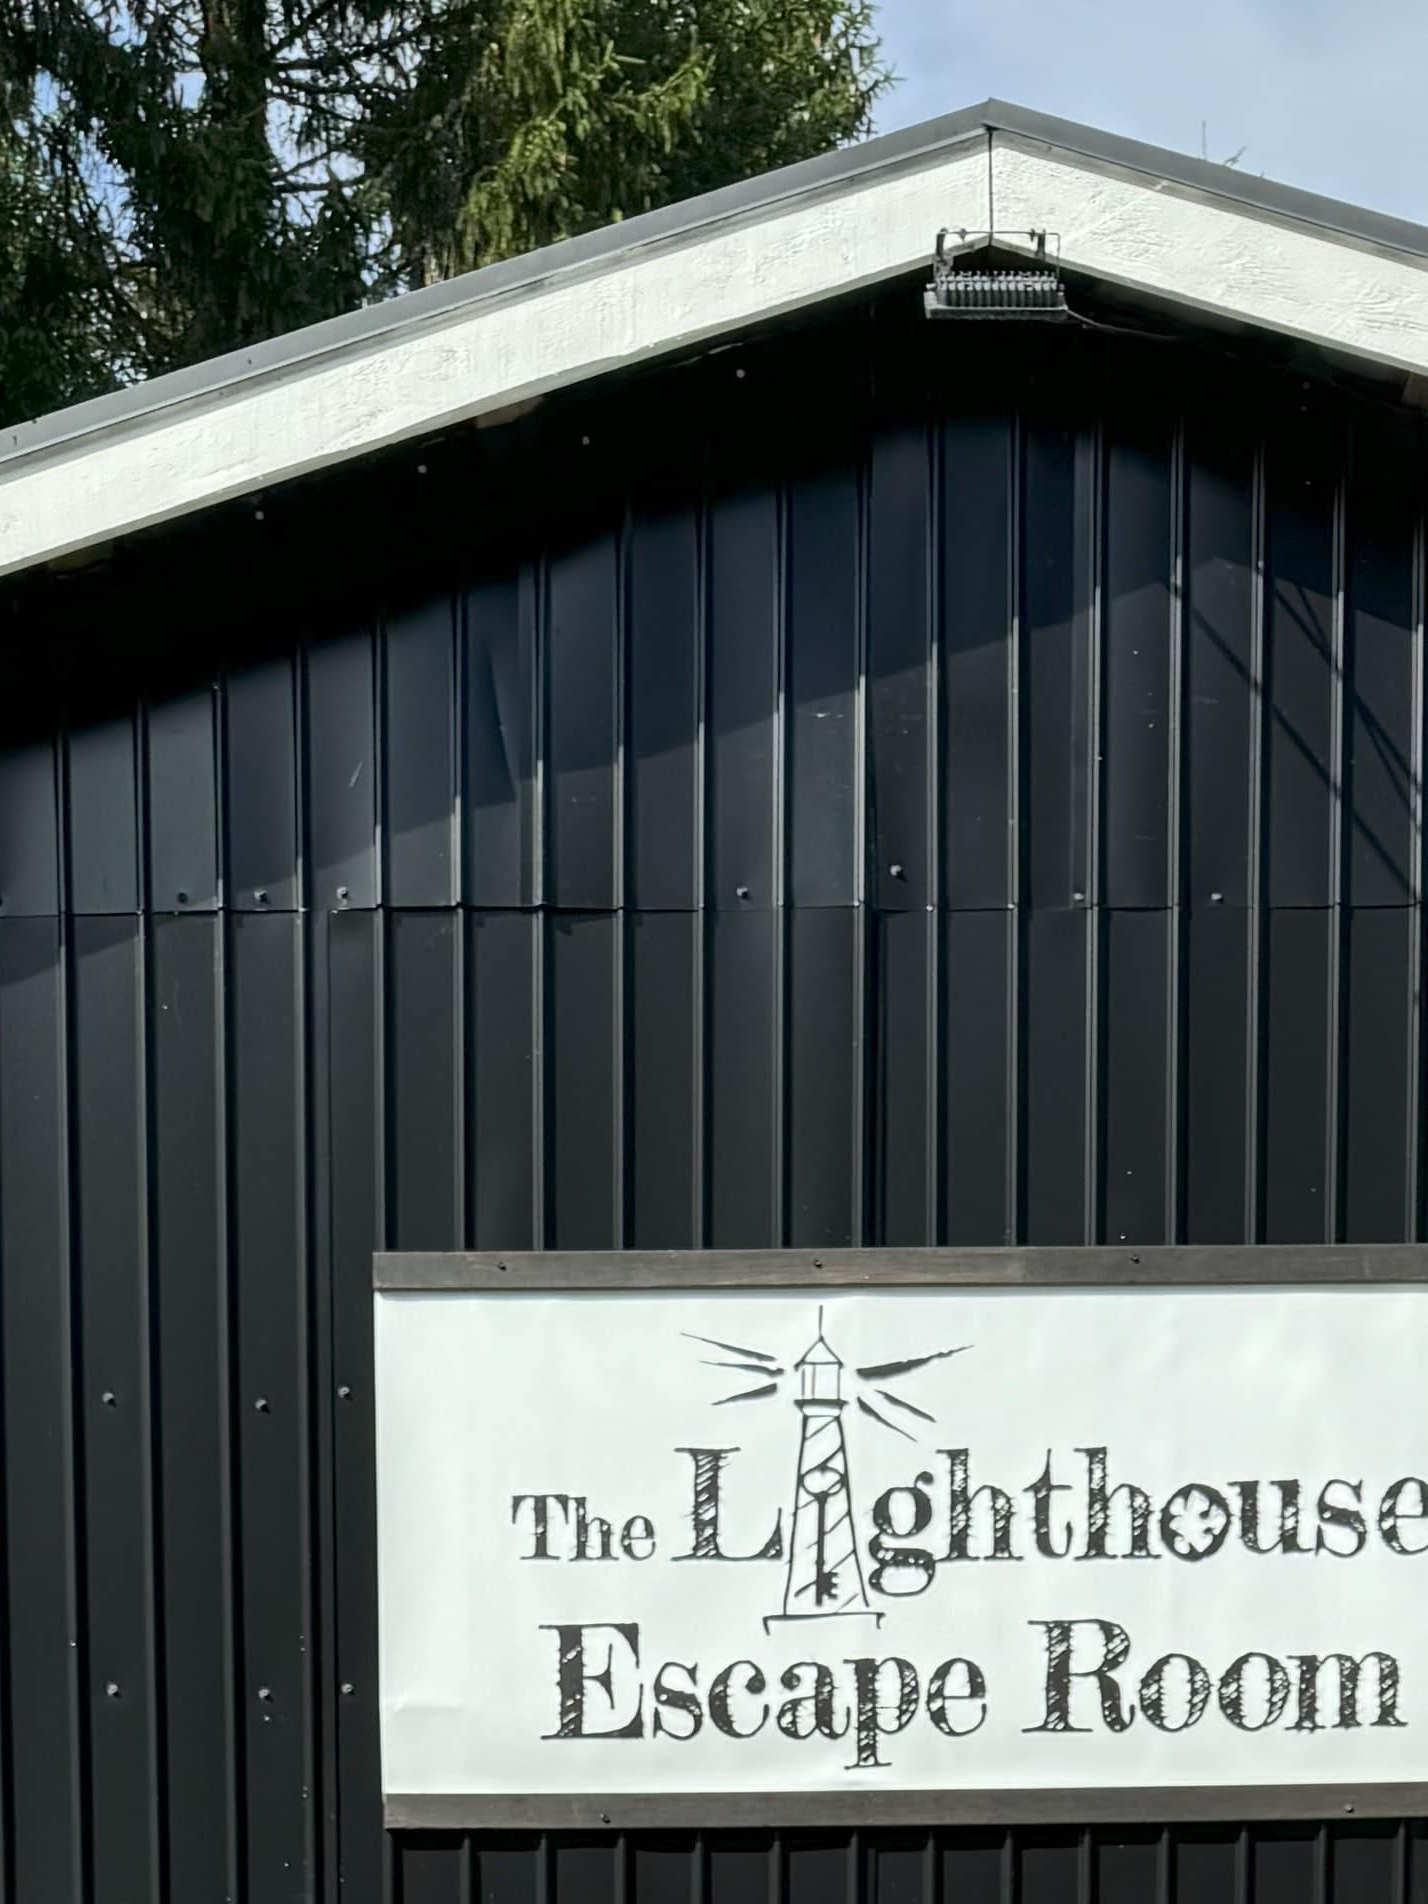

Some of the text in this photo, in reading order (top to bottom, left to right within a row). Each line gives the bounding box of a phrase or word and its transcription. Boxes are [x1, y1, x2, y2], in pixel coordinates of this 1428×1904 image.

[511, 1493, 656, 1562] The
[539, 1618, 1409, 1769] Escape Room
